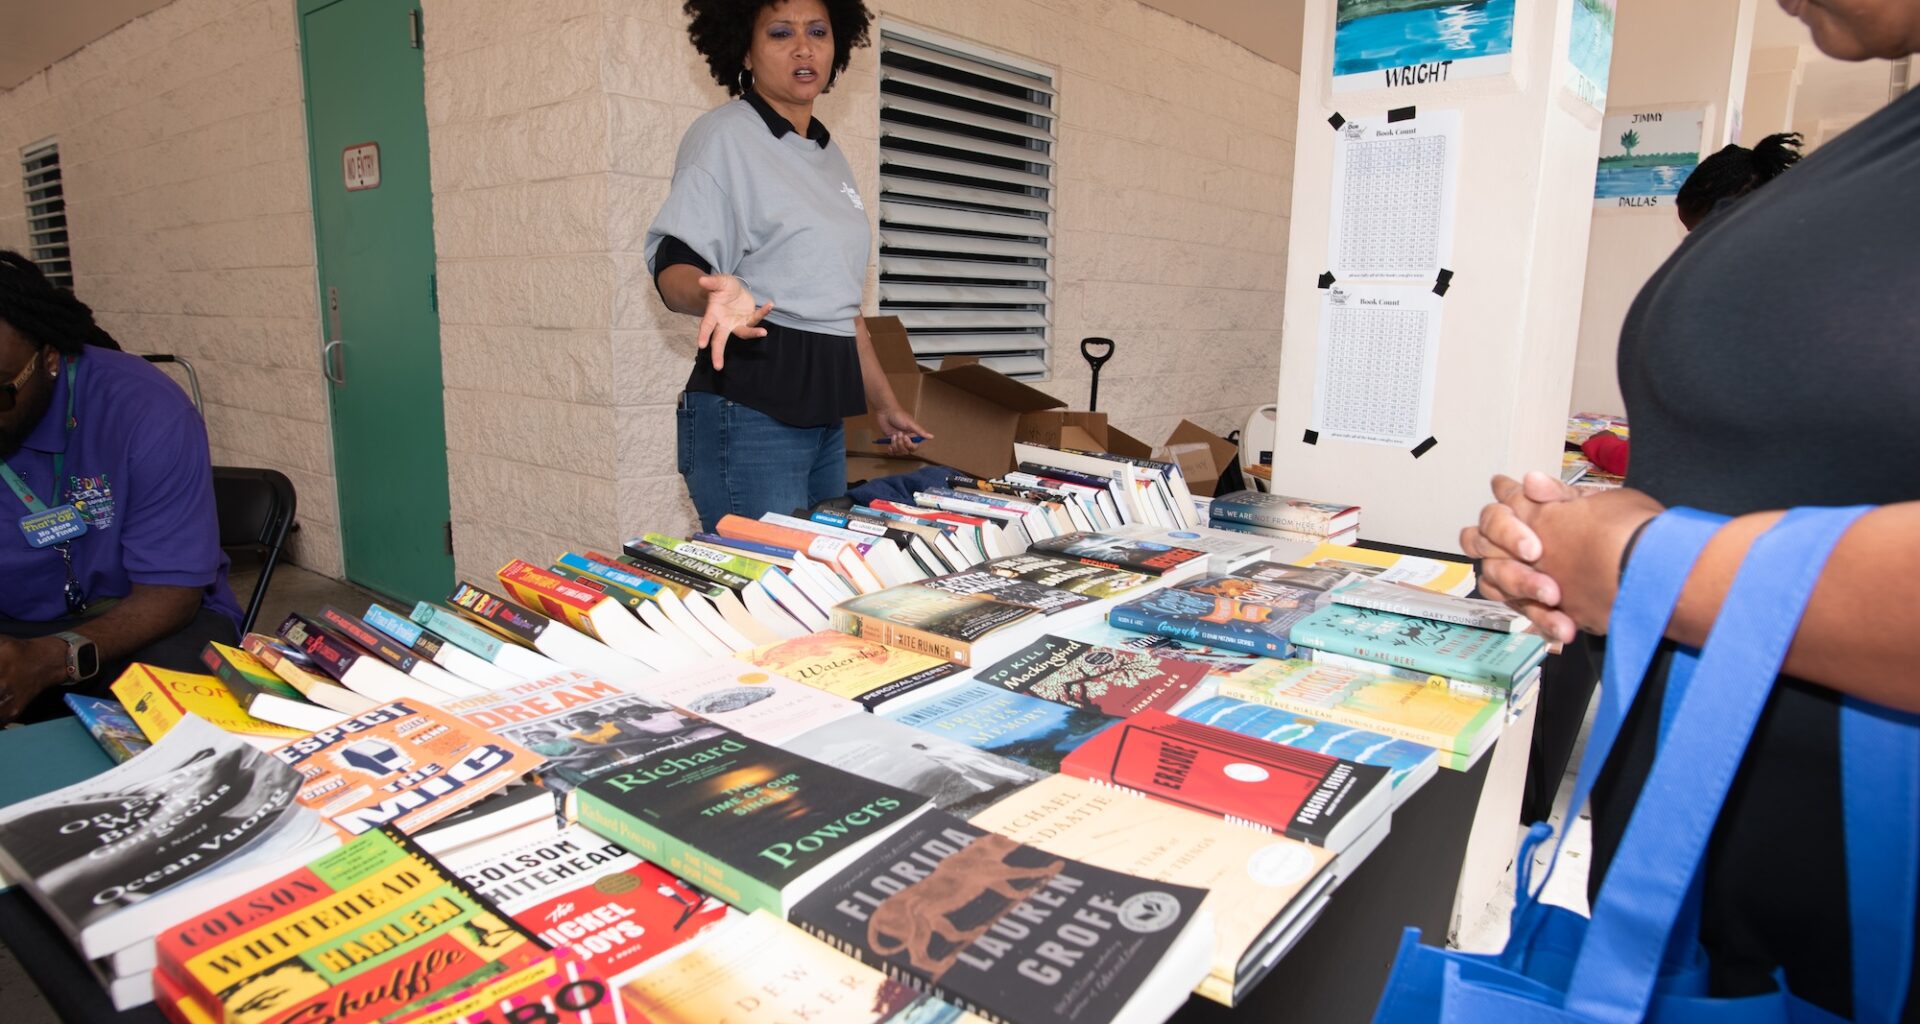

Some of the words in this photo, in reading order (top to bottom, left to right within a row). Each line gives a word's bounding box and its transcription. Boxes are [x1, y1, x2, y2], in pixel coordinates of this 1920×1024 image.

[1385, 61, 1453, 88] WRIGHT
[1395, 128, 1416, 136] Count
[1632, 113, 1664, 124] JIMMY
[346, 157, 356, 180] NO
[357, 154, 374, 178] ENTRY
[23, 519, 56, 533] That's
[58, 512, 76, 523] OK!
[37, 534, 55, 545] Late
[56, 525, 79, 538] Fines!
[38, 530, 50, 538] No
[51, 522, 71, 533] More
[1227, 510, 1237, 518] WE
[1238, 511, 1252, 520] ARE
[1254, 514, 1270, 522] NOT
[1272, 517, 1293, 526] FROM
[1296, 521, 1316, 529] HERE
[662, 548, 686, 568] MAZE
[683, 555, 724, 579] RUNNER
[679, 544, 728, 562] CONCEALED
[643, 565, 662, 577] COLD
[665, 574, 690, 584] BLOOD
[474, 594, 504, 618] BUCK
[1341, 596, 1365, 608] THE
[1367, 599, 1410, 614] SPEECH
[1422, 610, 1445, 621] GARY
[1447, 614, 1482, 626] YOUNGE
[899, 634, 916, 649] KITE
[917, 638, 951, 656] RUNNER
[1157, 620, 1181, 635] Coming
[1187, 626, 1200, 638] Age
[798, 645, 890, 680] Watershed
[989, 670, 1009, 682] TO
[1011, 650, 1045, 671] KILL
[1047, 643, 1057, 651] A
[1003, 640, 1081, 691] Mockingbird
[1354, 647, 1369, 657] YOU
[1372, 651, 1389, 661] ARE
[1394, 656, 1416, 667] HERE
[441, 692, 504, 714] MORE
[510, 674, 562, 697] THAN
[569, 670, 586, 680] A
[863, 678, 911, 701] PERCIVAL
[912, 663, 955, 682] EVERETT
[1130, 688, 1167, 714] HARPER
[1164, 673, 1182, 689] LEE
[461, 679, 626, 730] DREAM
[1226, 690, 1244, 699] HOW
[1248, 694, 1260, 702] TO
[1263, 697, 1290, 710] LEAVE
[1293, 704, 1333, 720] HIALEAH
[272, 702, 418, 765] ESPECT
[967, 707, 1048, 745] MEMORY
[1340, 716, 1373, 729] JENNINE
[1400, 730, 1432, 743] CRUCET
[379, 762, 444, 793] THE
[604, 739, 749, 795] Richard
[1153, 741, 1200, 790] ERASURE
[330, 744, 515, 836] MIC
[701, 795, 740, 817] TIME
[741, 787, 765, 801] OF
[767, 772, 800, 789] OUR
[720, 782, 757, 796] THE
[733, 785, 799, 817] SINGING
[1297, 788, 1328, 825] PERCIVAL
[1325, 764, 1355, 792] EVERETT
[60, 809, 115, 834] On
[89, 783, 230, 860] Gorgeous
[98, 790, 201, 845] Briefly
[581, 802, 619, 832] Richard
[619, 817, 658, 852] Powers
[757, 794, 900, 869] Powers
[1001, 791, 1081, 834] ICHAEL
[1023, 796, 1113, 846] NDAATJE
[92, 855, 201, 904] Ocean
[199, 787, 289, 851] Vuong
[461, 840, 582, 891] COLSON
[483, 844, 625, 905] HITEHEAD
[835, 827, 977, 922] FLORIDA
[179, 877, 318, 947] COLSON
[209, 871, 421, 976] WHITEHEAD
[545, 901, 576, 923] The
[956, 872, 1084, 972] LAUREN
[316, 897, 465, 973] HARLEM
[615, 943, 642, 961] NOVEL
[1017, 890, 1125, 986] GROFF
[800, 919, 863, 962] FLORIDA
[881, 961, 945, 1002] LAUREN
[275, 946, 467, 1024] Shuffle
